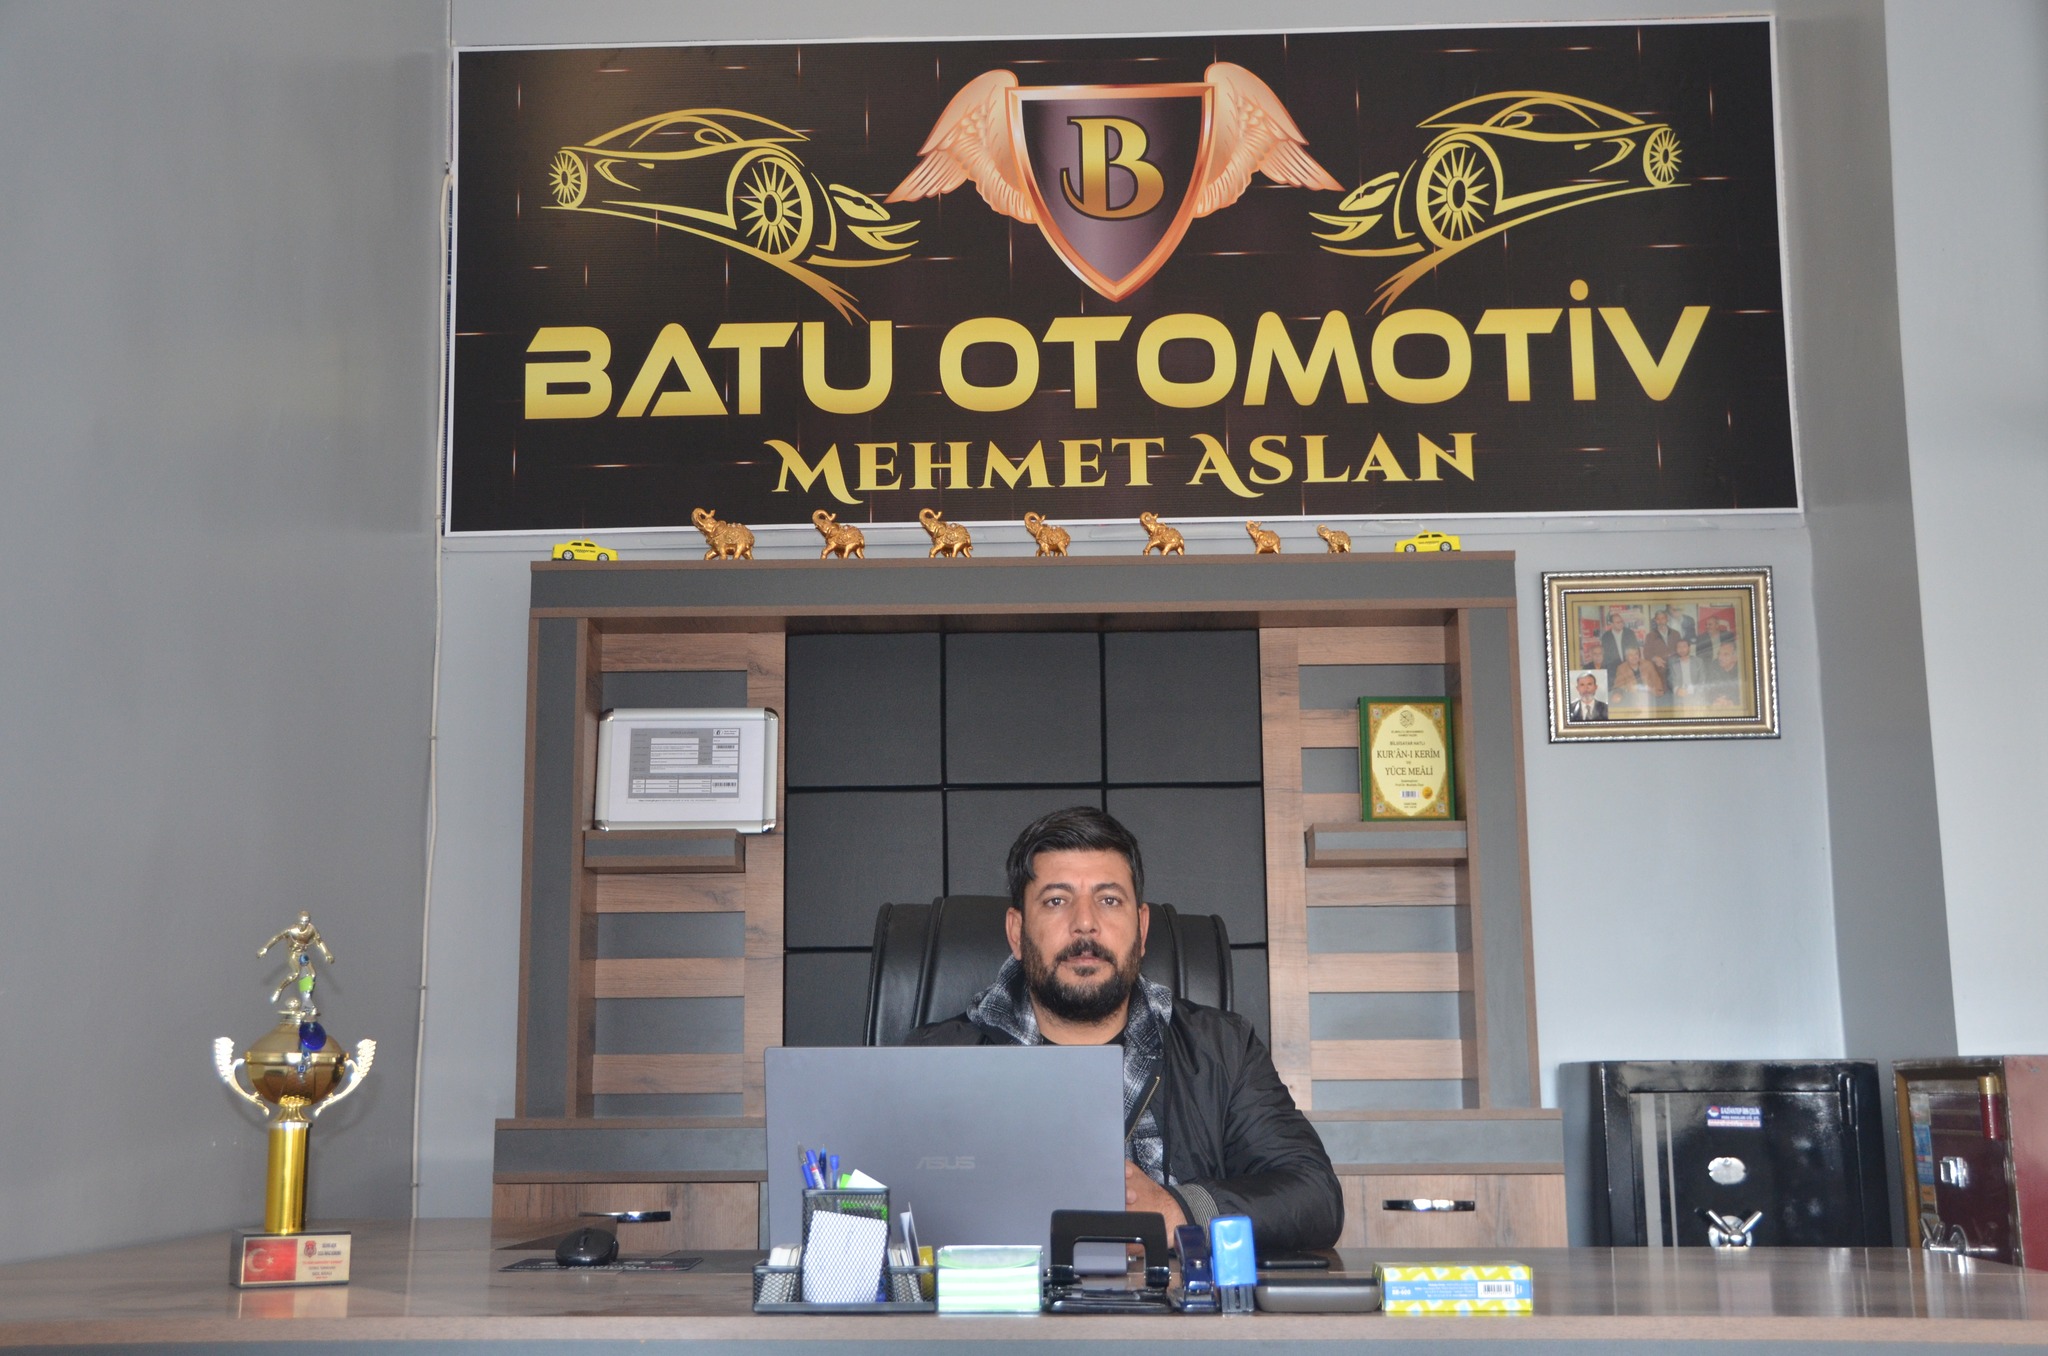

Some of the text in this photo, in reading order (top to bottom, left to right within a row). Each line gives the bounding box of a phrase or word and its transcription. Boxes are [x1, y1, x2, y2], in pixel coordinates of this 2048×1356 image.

[524, 279, 1711, 420] BATU OTOMOTİV
[763, 432, 1477, 505] MEHMET ASLAN
[916, 1155, 976, 1170] ASUS
